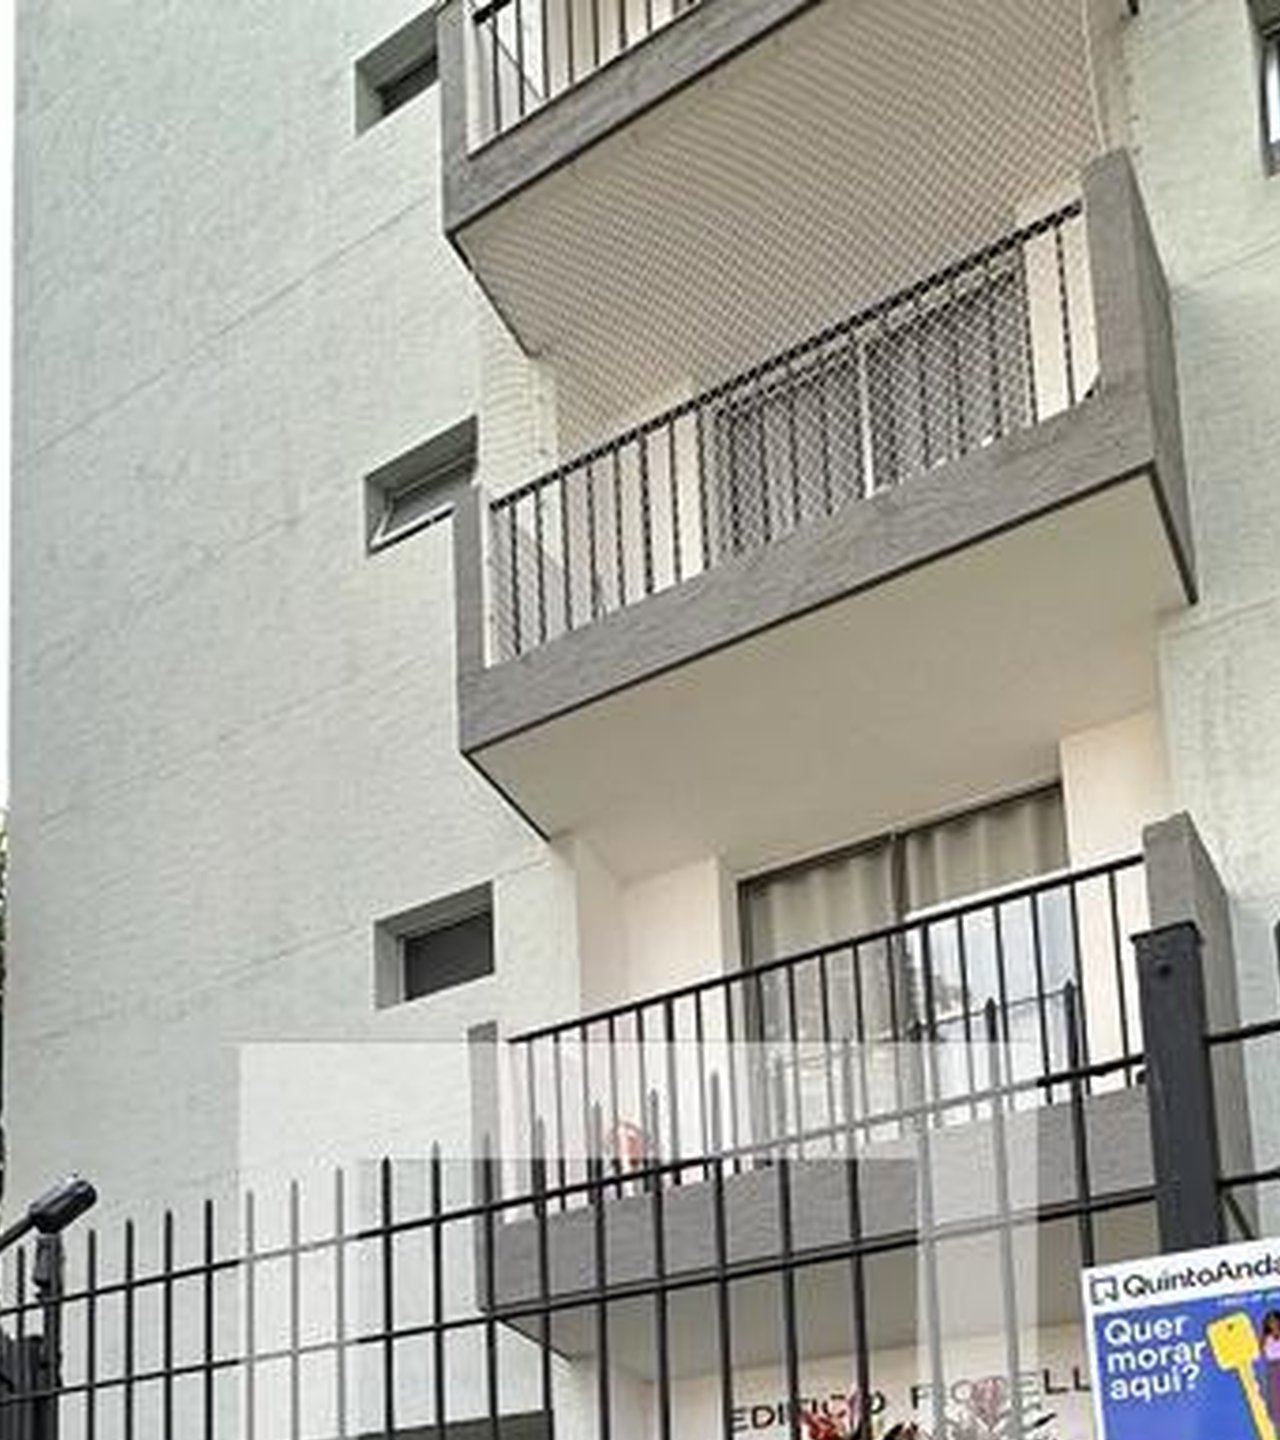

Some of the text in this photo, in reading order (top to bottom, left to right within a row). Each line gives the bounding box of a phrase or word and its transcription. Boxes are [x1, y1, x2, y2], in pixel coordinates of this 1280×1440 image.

[1104, 1315, 1188, 1346] Quer
[1107, 1341, 1206, 1373] morar
[1110, 1365, 1200, 1401] aqui?
